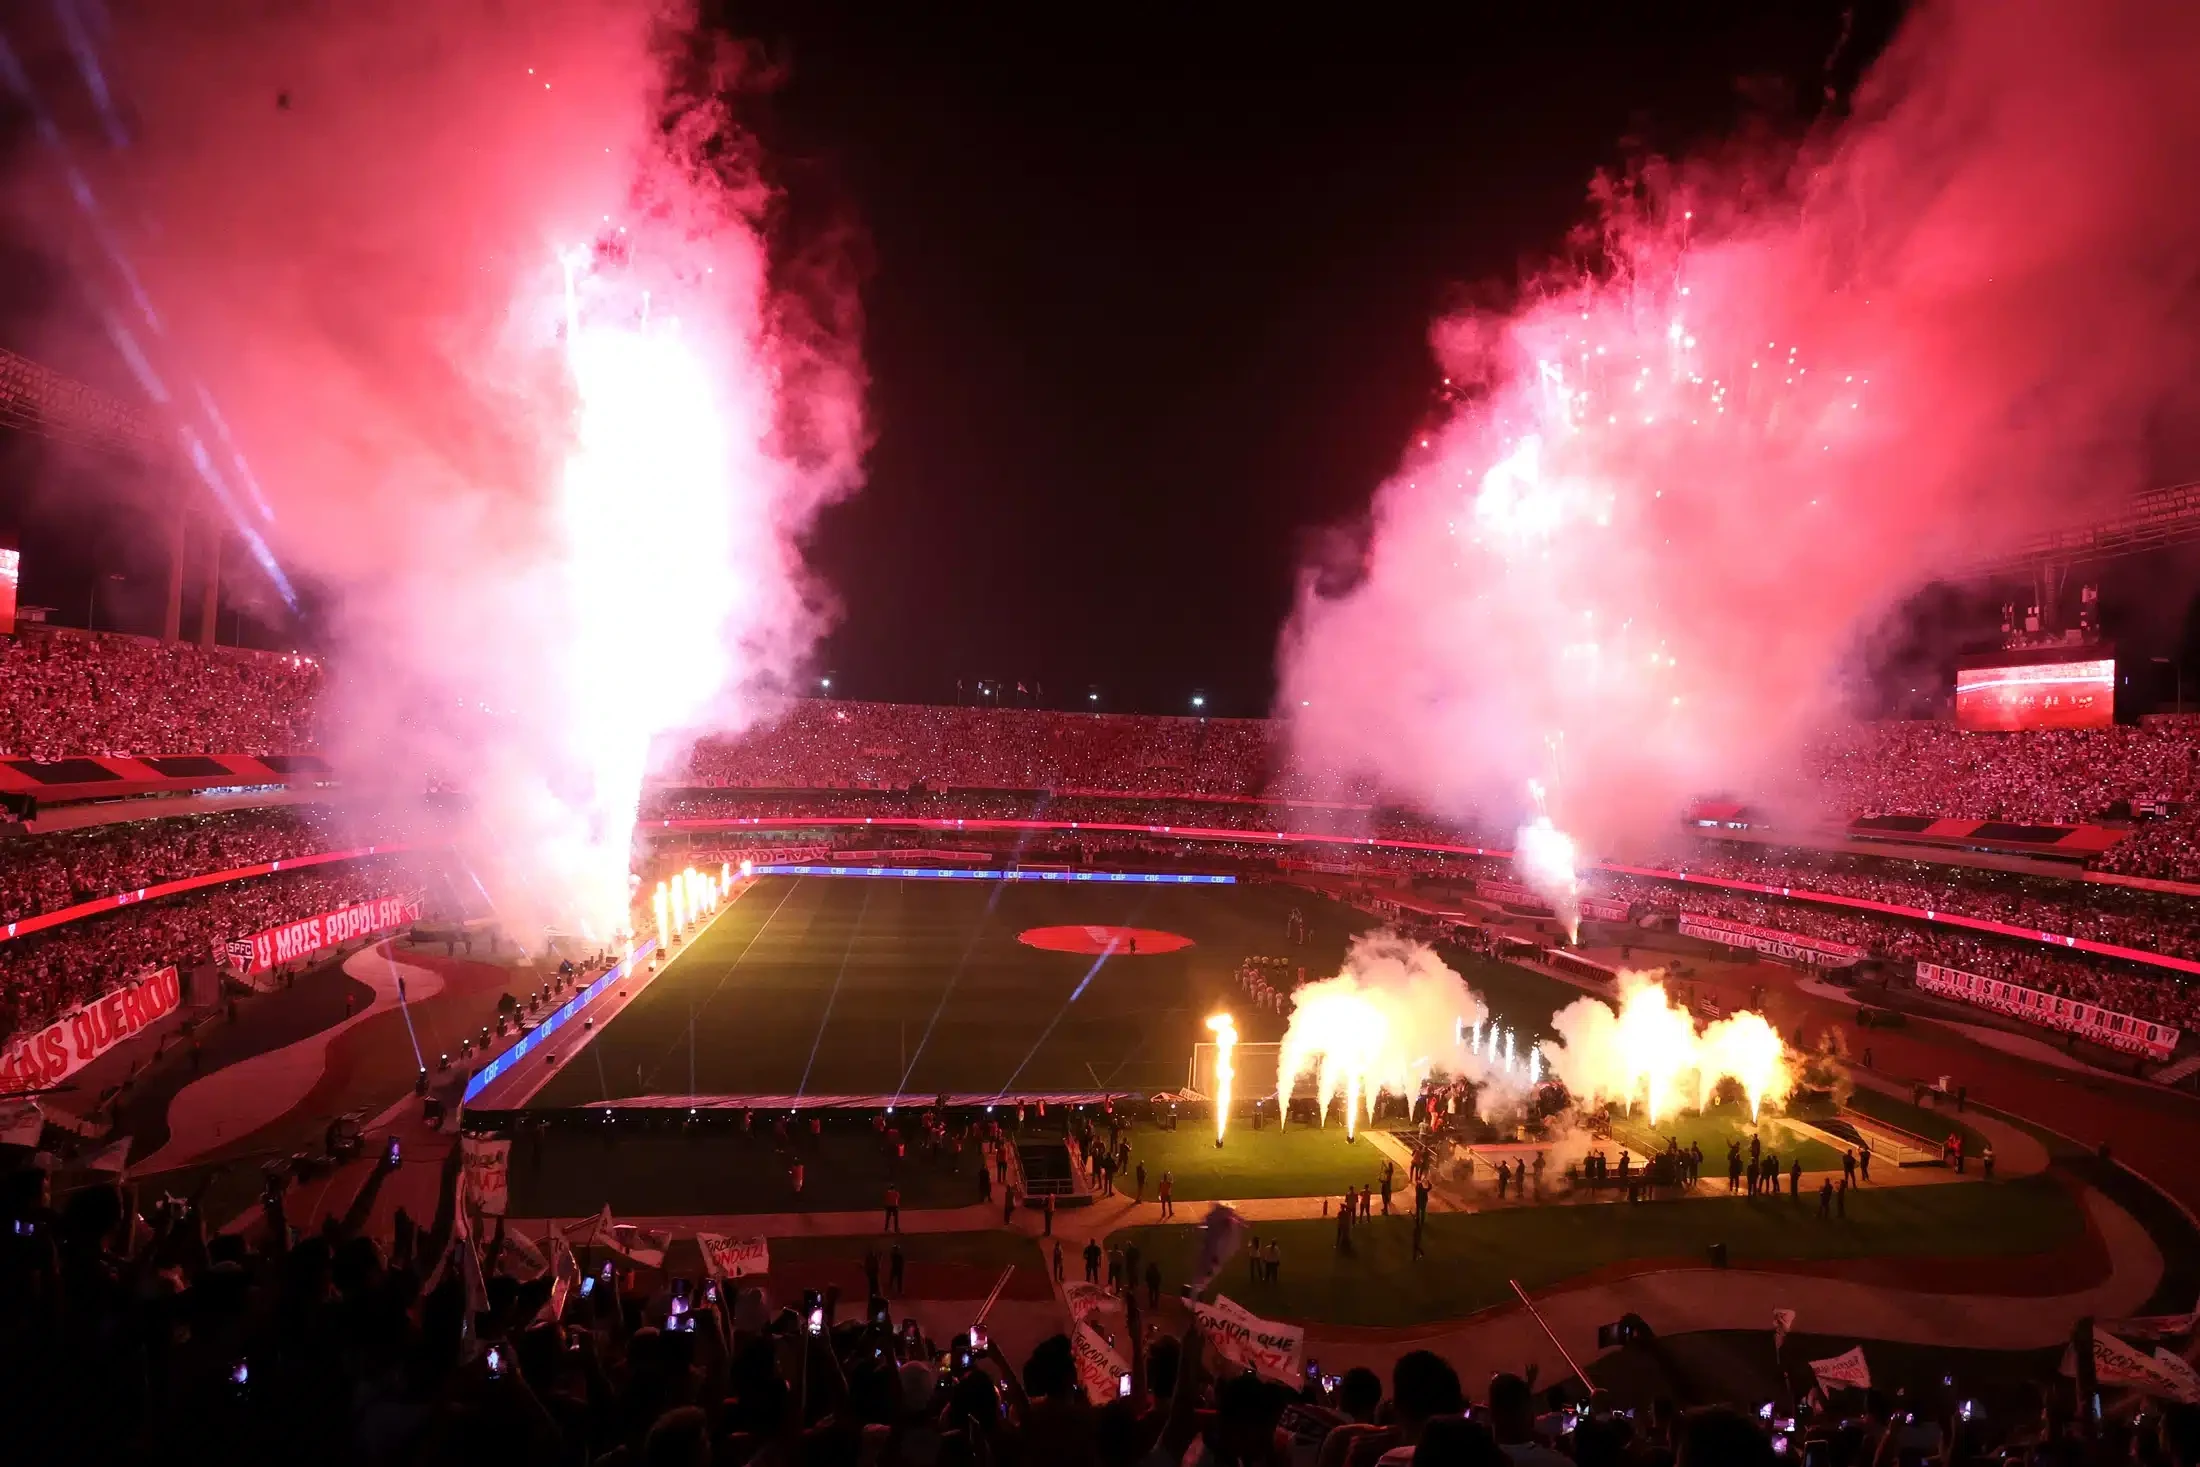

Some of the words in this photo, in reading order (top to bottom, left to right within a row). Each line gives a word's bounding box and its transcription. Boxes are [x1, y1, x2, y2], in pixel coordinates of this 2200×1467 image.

[758, 866, 774, 874] CBF
[867, 868, 882, 876] CBF
[227, 941, 252, 956] SPFC
[276, 918, 320, 963] MAIS
[326, 900, 402, 944] POPULAR
[1768, 941, 1796, 957] TENS
[72, 966, 178, 1060] QUERIDO
[1930, 966, 1974, 990] DENTRE
[1975, 979, 1992, 994] OS
[1993, 982, 2053, 1012] GRANDES
[2073, 1004, 2084, 1020] O
[2086, 1007, 2158, 1042] PRIMEIRO
[484, 1061, 499, 1085] CBF
[515, 1037, 528, 1060] CBF
[541, 1017, 553, 1038] CBF
[564, 1001, 574, 1019] CBF
[1075, 1332, 1108, 1369] TORCIDA
[1257, 1332, 1296, 1352] QUE
